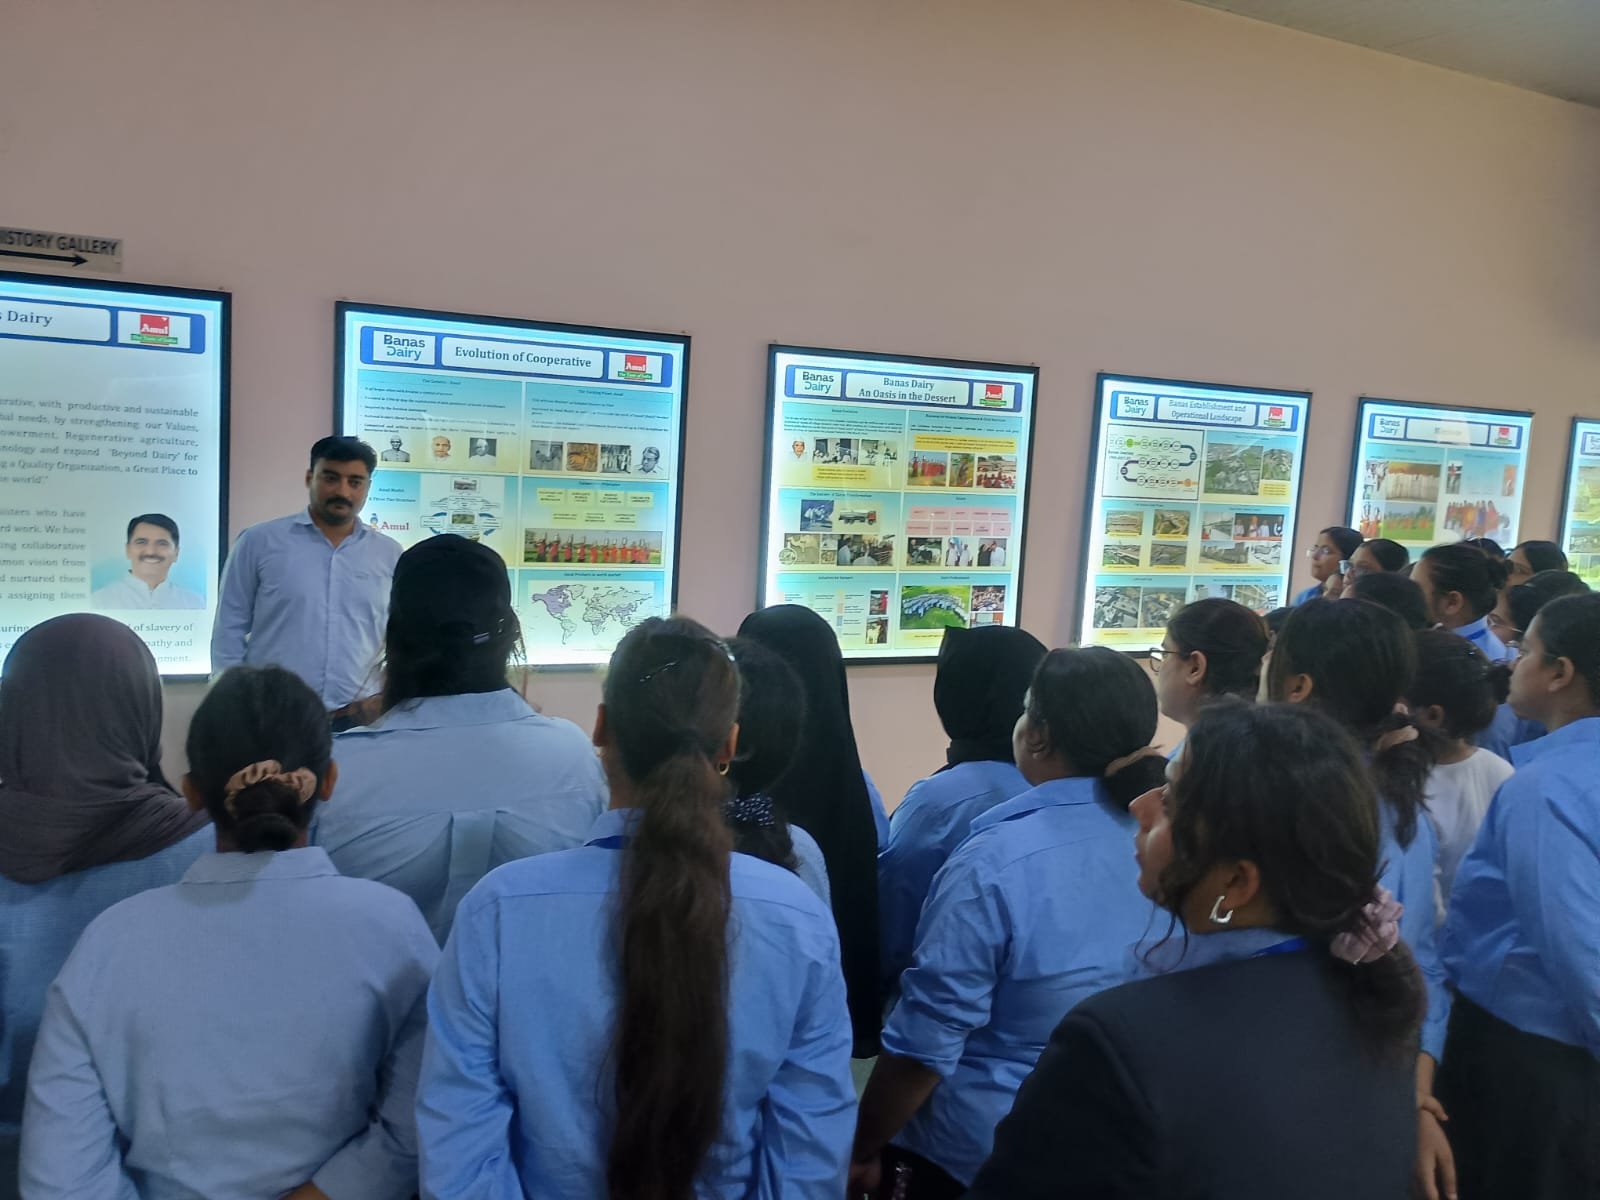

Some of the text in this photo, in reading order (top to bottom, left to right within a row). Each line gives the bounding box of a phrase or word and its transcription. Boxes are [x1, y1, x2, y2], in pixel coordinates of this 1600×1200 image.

[0, 230, 118, 256] STORY GALLERY
[8, 311, 53, 328] Dairy
[383, 334, 426, 350] Banas
[386, 347, 422, 362] Dairy
[455, 346, 593, 369] Evolution of Cooperative
[803, 370, 834, 384] Banas
[883, 376, 936, 392] Banas Dairy
[804, 381, 832, 395] Dairy
[859, 388, 957, 404] An Oasis in the Dessert
[39, 399, 62, 410] with
[67, 402, 121, 413] productive
[123, 404, 142, 415] and
[145, 406, 200, 418] sustainable
[1189, 400, 1233, 412] Establishment
[1233, 403, 1247, 413] and
[54, 415, 66, 426] by
[70, 417, 140, 431] strengthening
[145, 421, 163, 431] our
[1171, 410, 1243, 424] Operational Landscape
[65, 431, 135, 444] Regenerative
[40, 445, 60, 455] and
[63, 447, 100, 457] expand
[184, 451, 200, 462] for
[18, 459, 55, 472] Quality
[132, 464, 160, 474] Great
[161, 466, 187, 476] Place
[187, 467, 199, 476] to
[36, 509, 58, 518] who
[62, 509, 87, 518] have
[45, 524, 62, 534] We
[62, 525, 87, 535] have
[381, 521, 410, 531] Amul
[21, 540, 87, 551] collaborative
[28, 557, 59, 567] vision
[62, 557, 87, 568] from
[9, 574, 56, 584] nurtured
[59, 573, 87, 584] these
[7, 591, 56, 603] assigning
[60, 591, 87, 601] them
[133, 622, 145, 633] of
[145, 623, 182, 635] slavery
[182, 622, 195, 632] of
[173, 638, 194, 648] and
